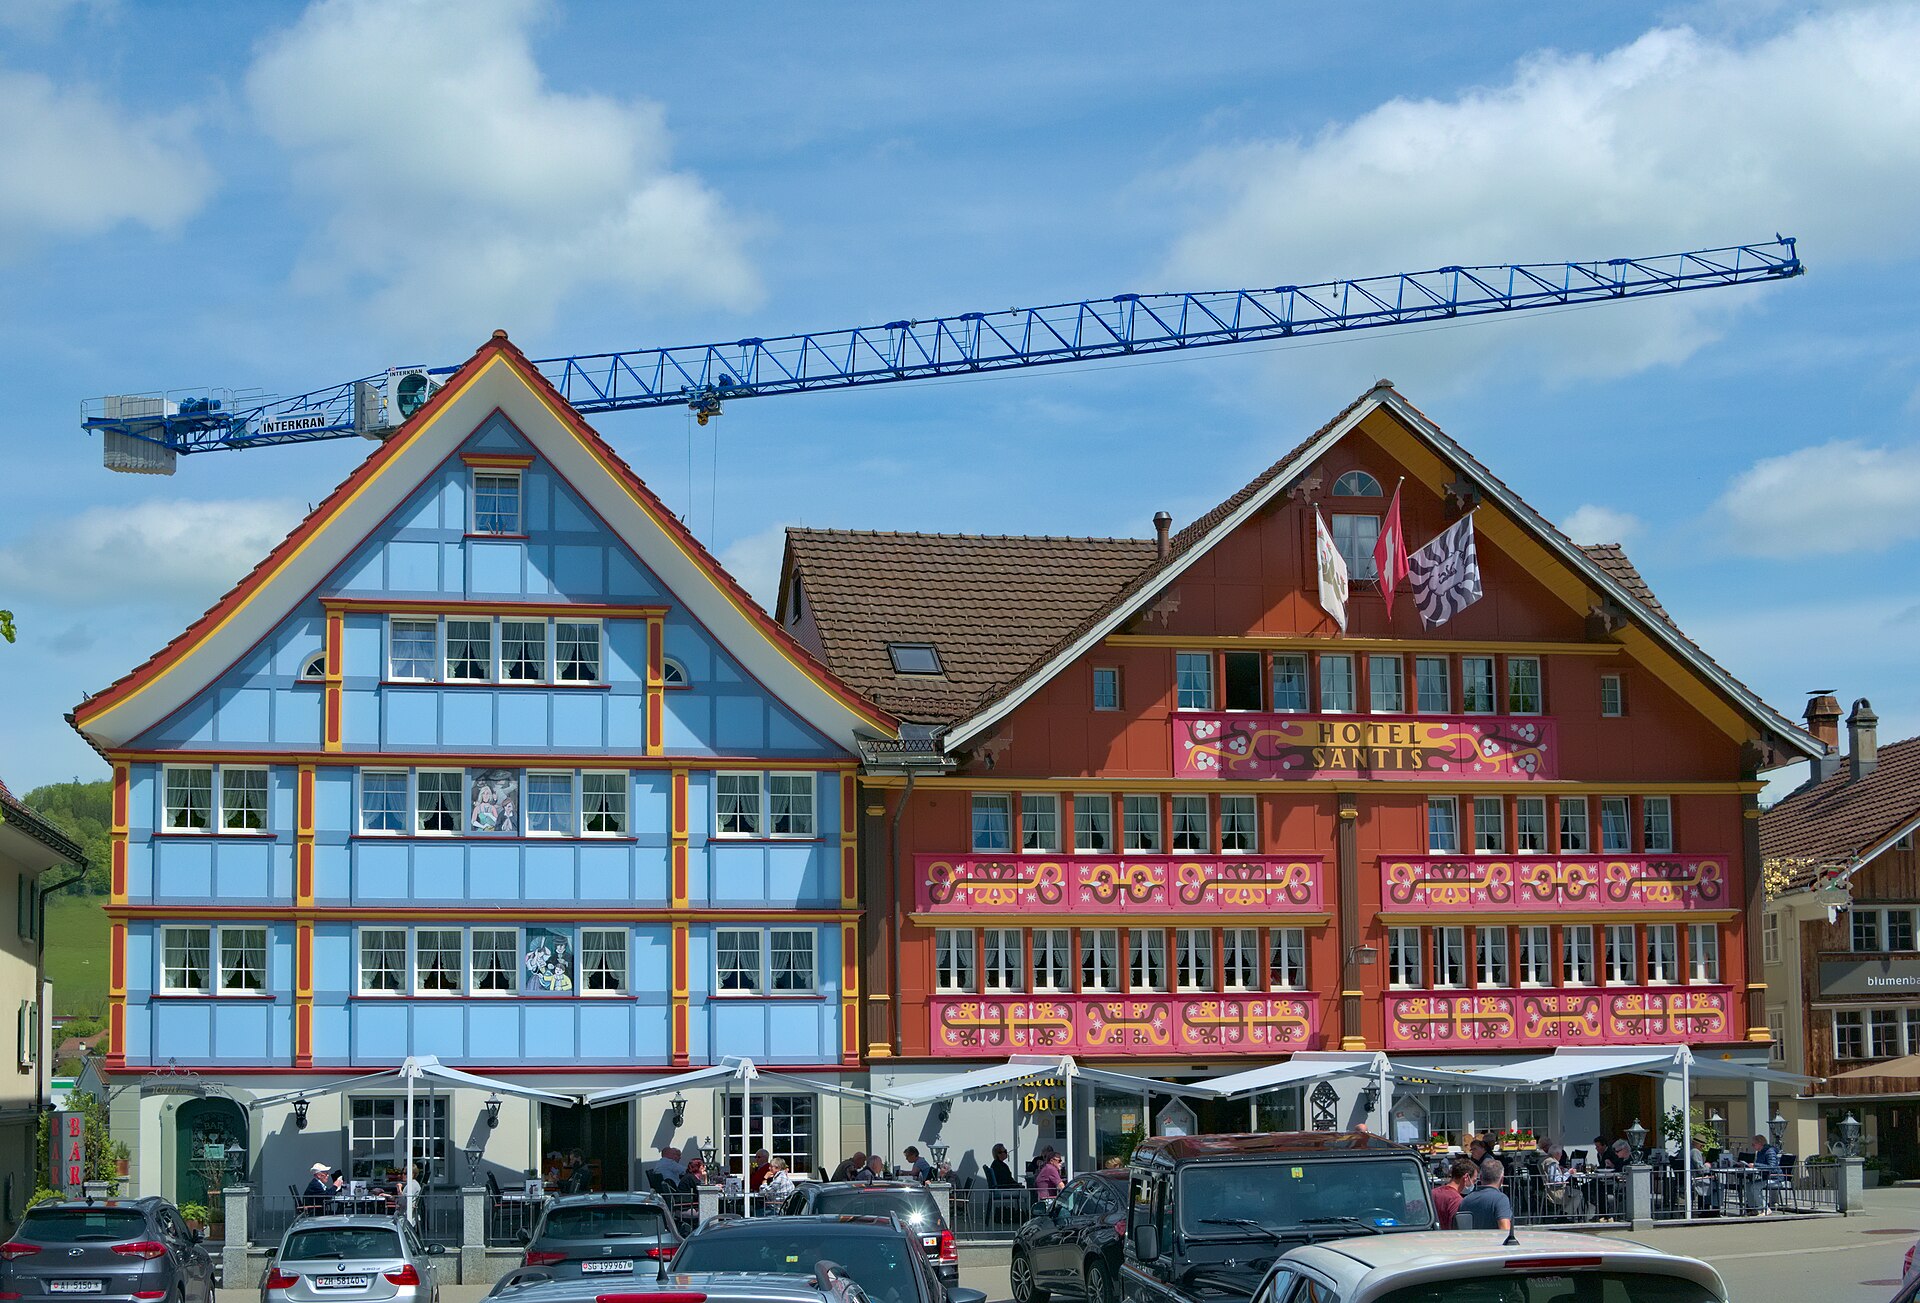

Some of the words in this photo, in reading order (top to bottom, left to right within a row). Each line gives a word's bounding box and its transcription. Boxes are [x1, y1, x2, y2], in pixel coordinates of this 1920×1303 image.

[389, 368, 423, 377] INTERKRAN
[263, 416, 325, 433] INTERKRAN
[1318, 723, 1422, 744] HOTEL
[1311, 747, 1423, 769] SÄNTIS
[1023, 1092, 1070, 1115] Hote
[51, 1117, 59, 1185] BAR
[69, 1116, 81, 1186] BAR
